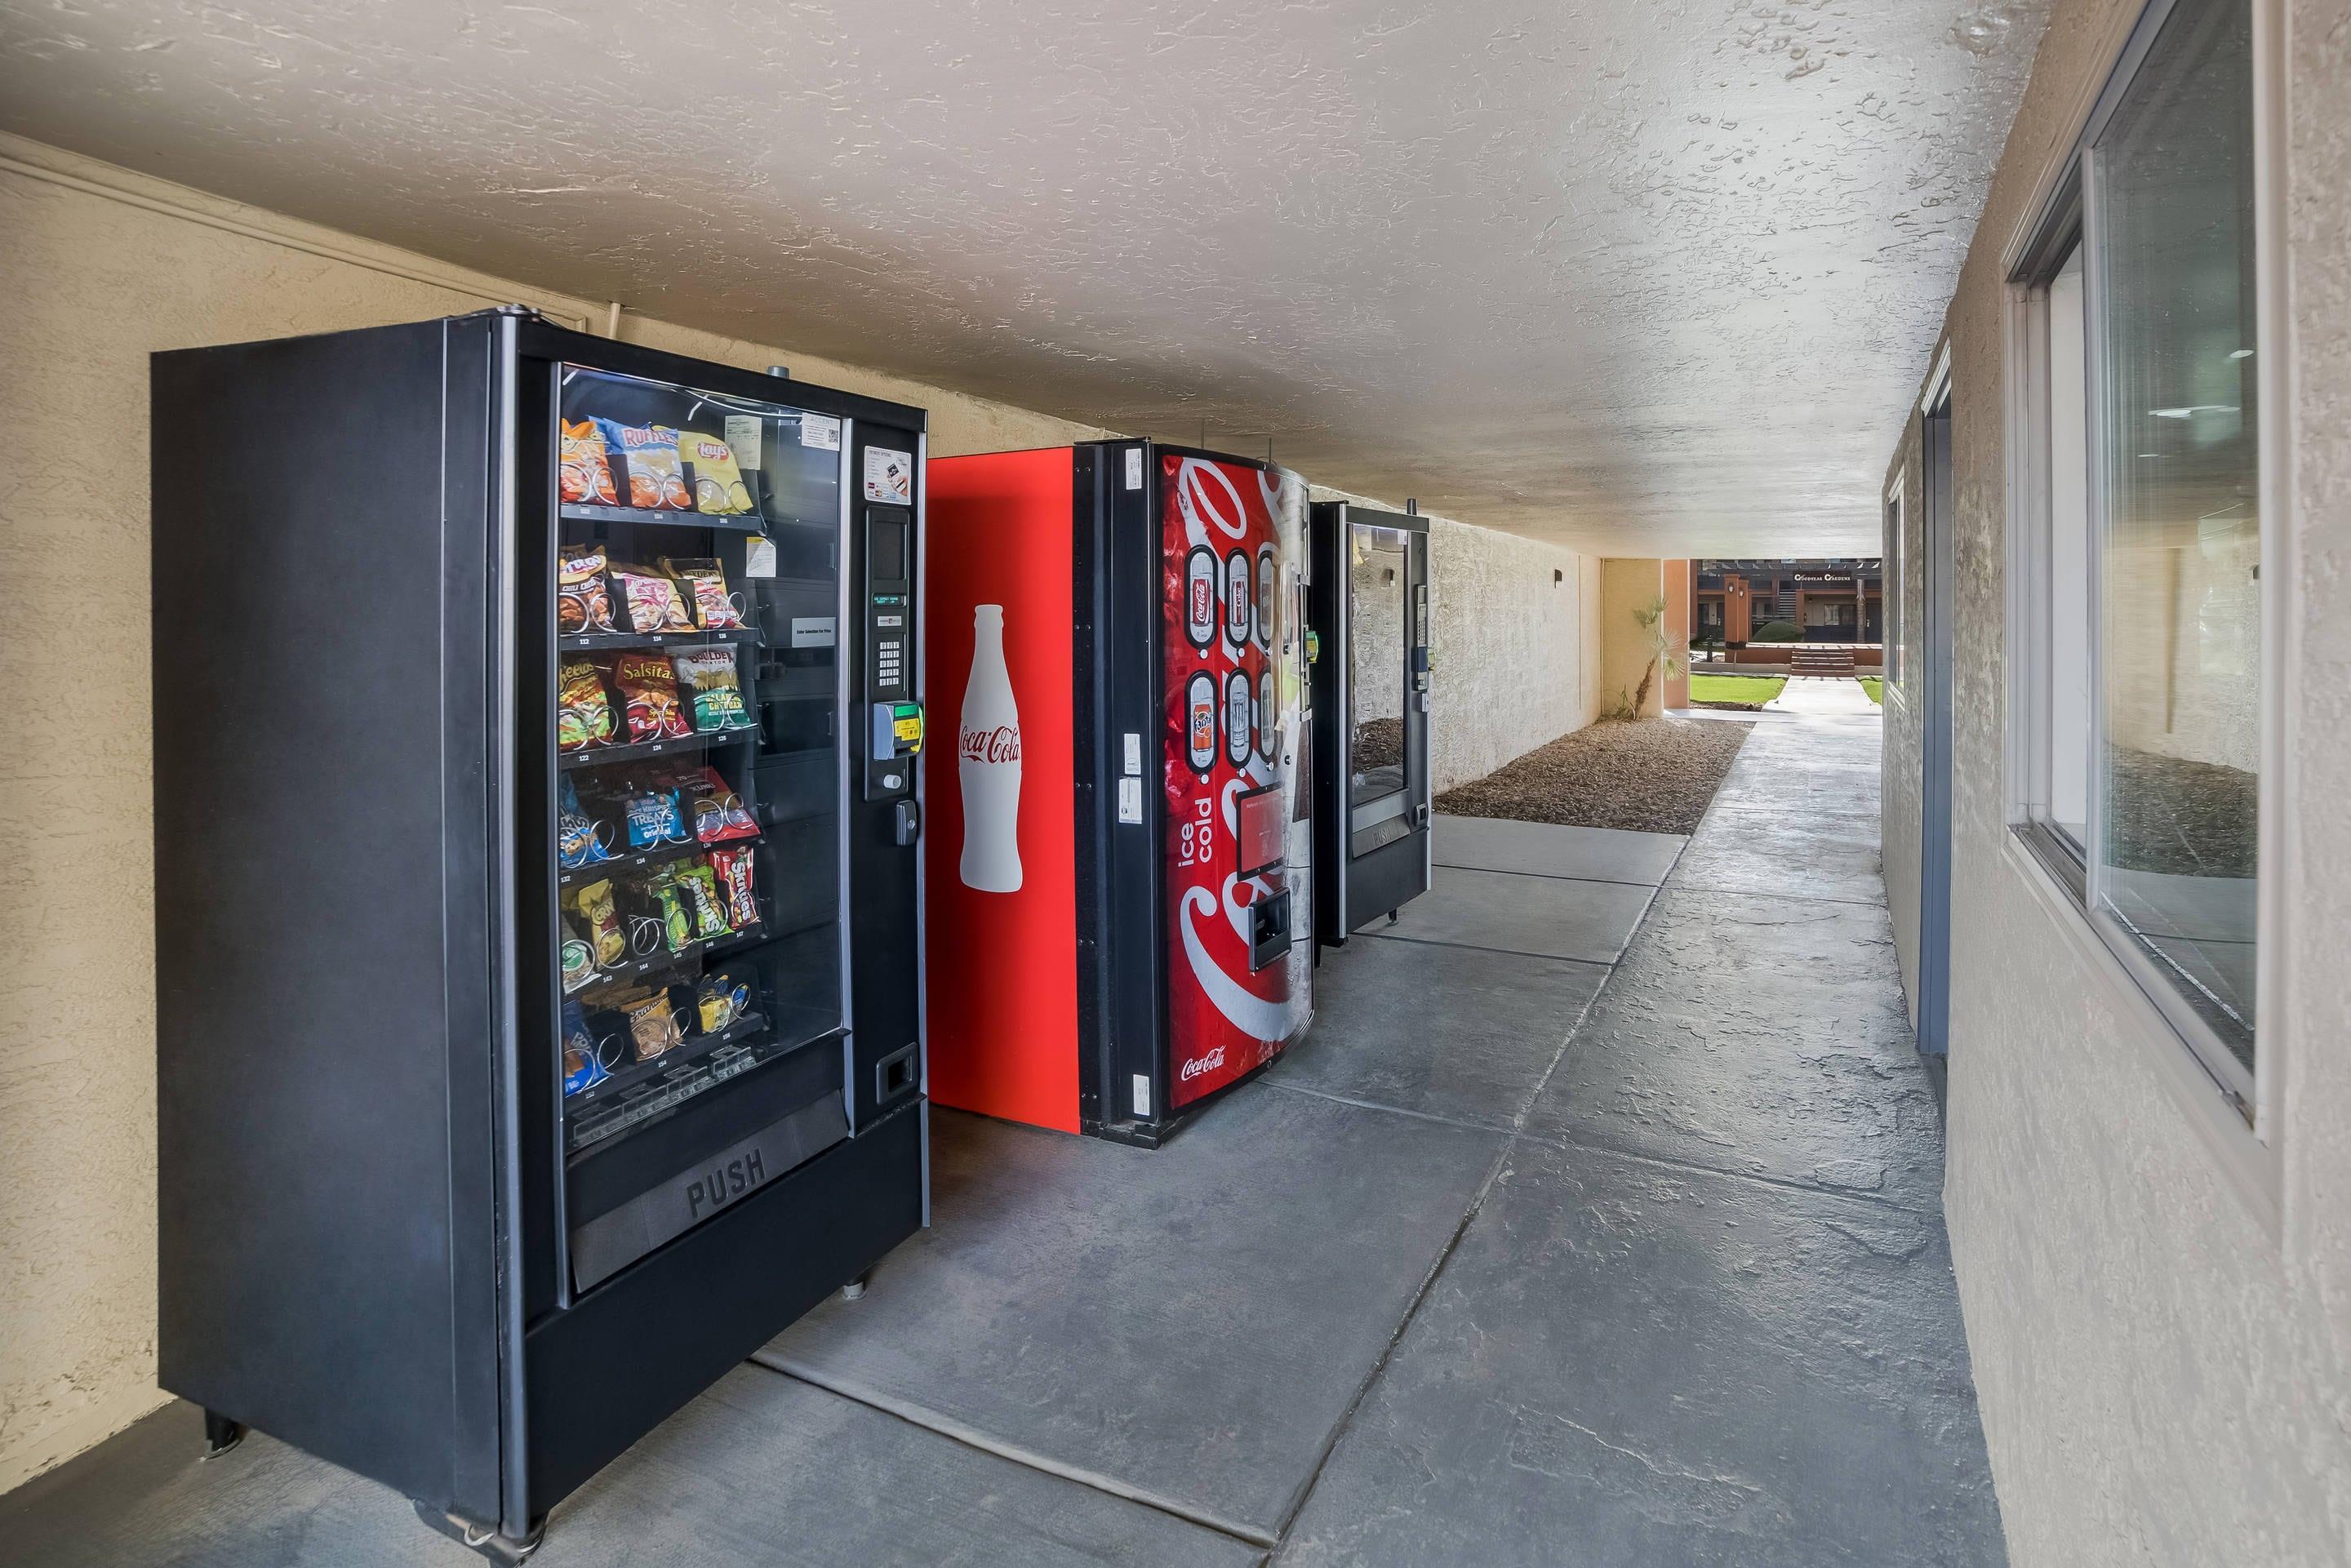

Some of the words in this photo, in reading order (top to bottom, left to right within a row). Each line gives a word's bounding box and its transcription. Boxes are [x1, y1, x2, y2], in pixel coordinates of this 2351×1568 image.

[699, 442, 727, 460] Lay's
[688, 651, 732, 664] BOULDER
[960, 726, 1020, 764] Coca-Cola
[632, 811, 674, 826] TREATS
[1195, 797, 1212, 863] cold
[1178, 823, 1194, 868] ice
[602, 975, 612, 983] 143
[1181, 1045, 1226, 1081] Coca-Cola
[686, 1148, 767, 1218] PUSH
